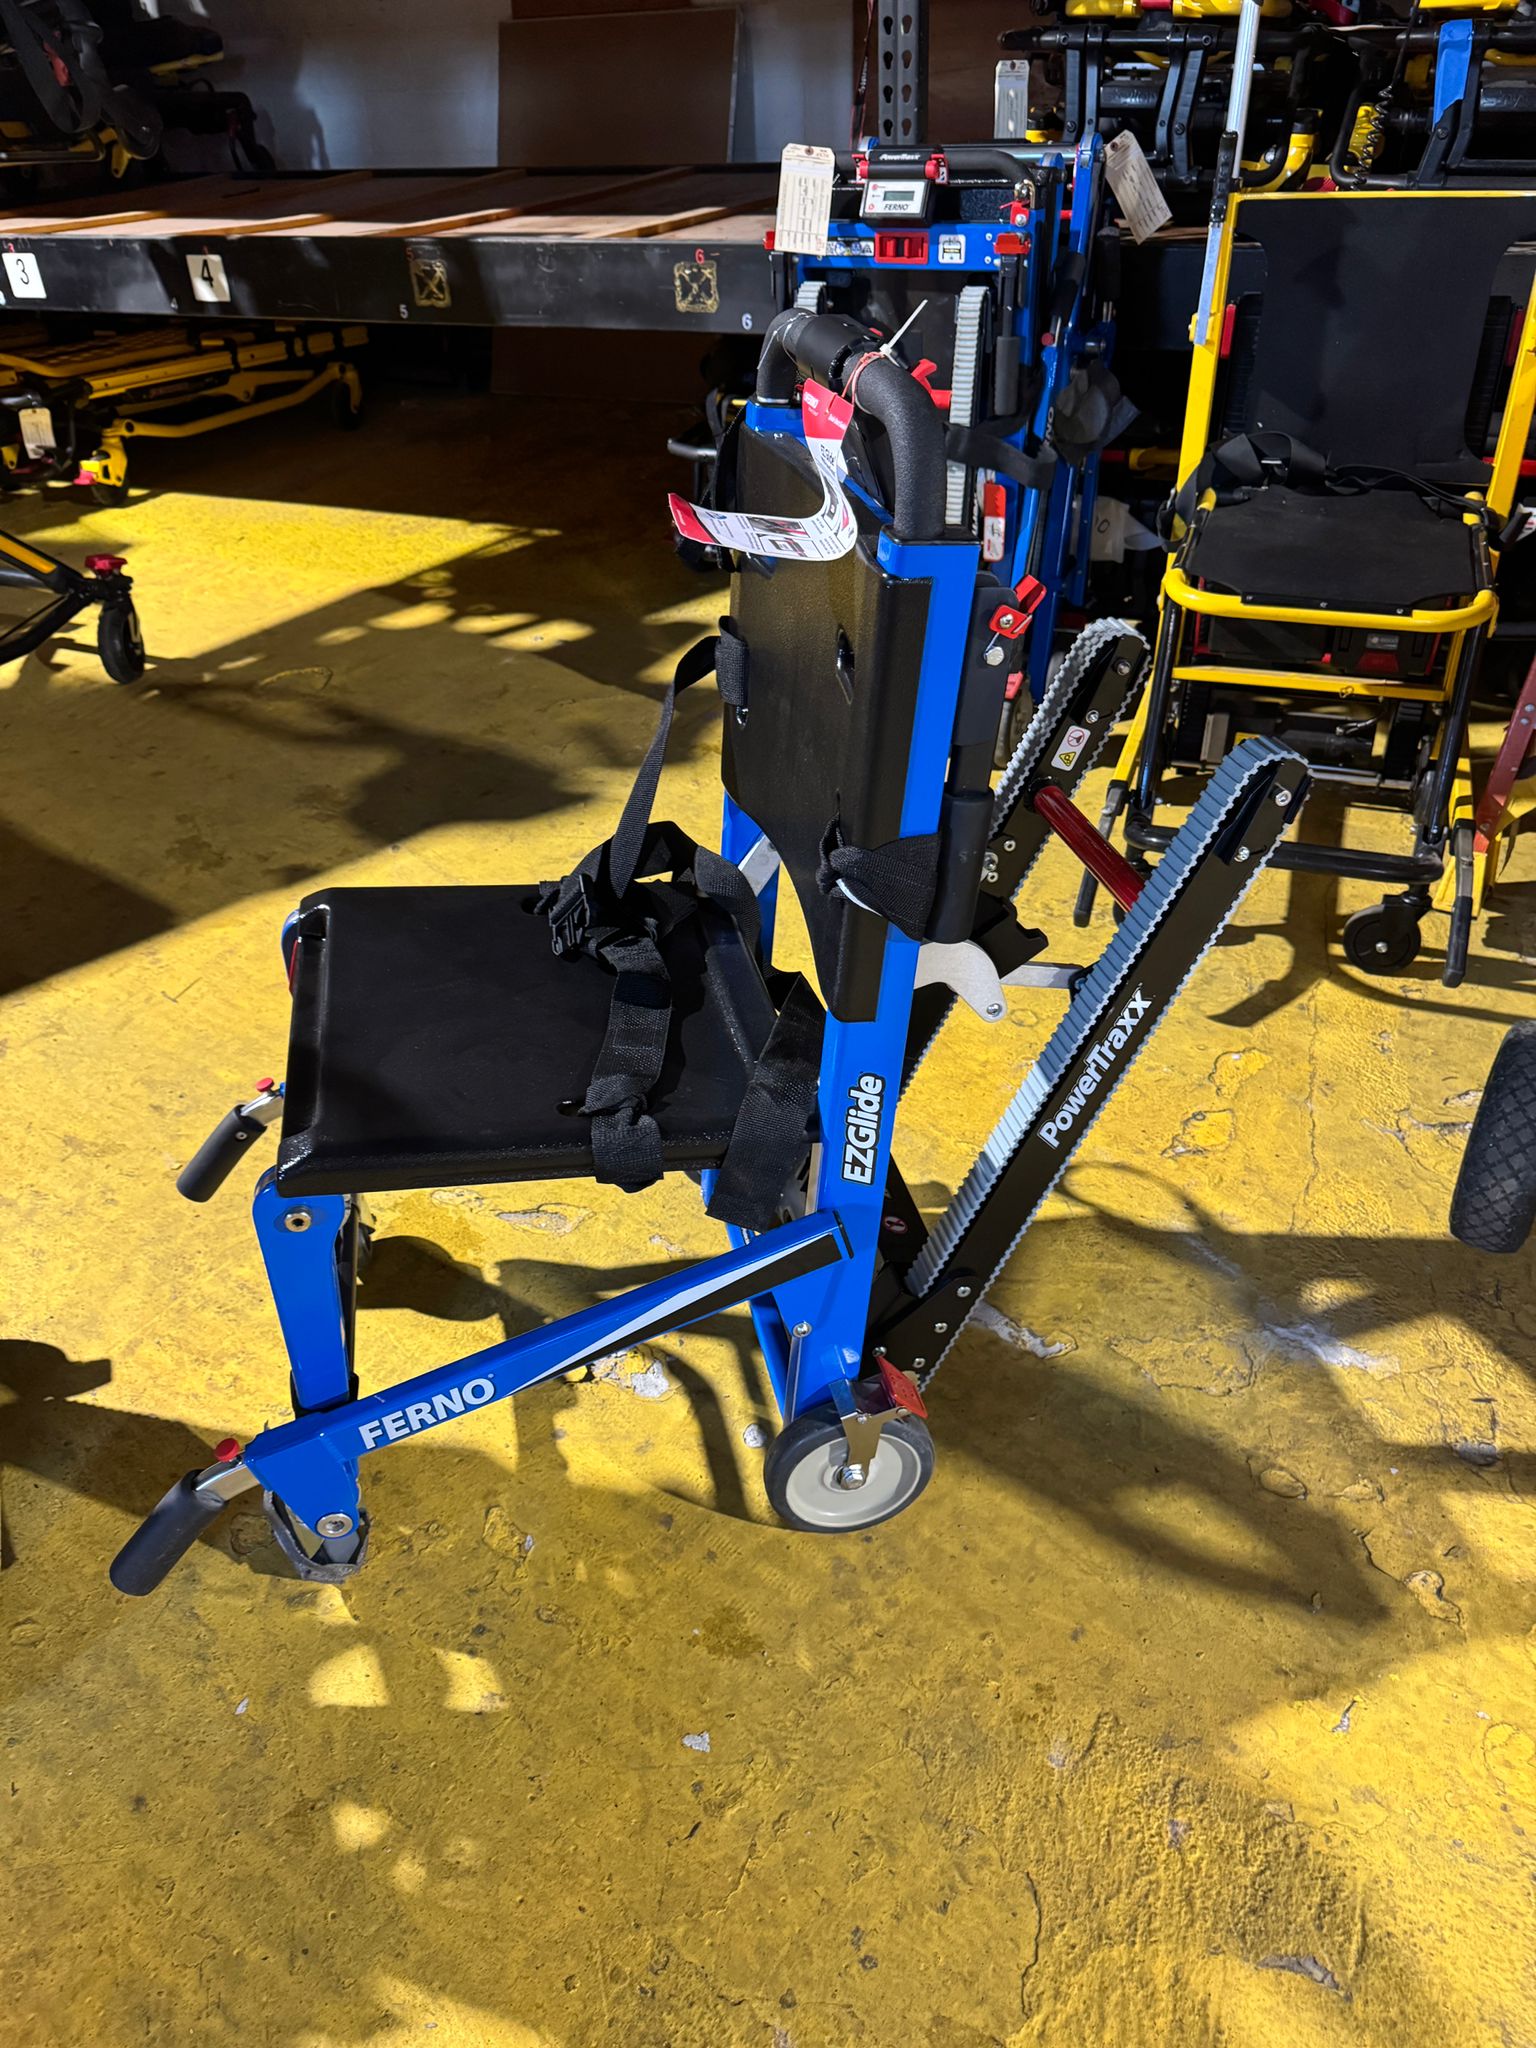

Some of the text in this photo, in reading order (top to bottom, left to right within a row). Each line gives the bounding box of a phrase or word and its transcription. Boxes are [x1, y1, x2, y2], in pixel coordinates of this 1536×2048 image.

[883, 203, 910, 212] FERNO
[695, 248, 705, 265] 6
[15, 258, 30, 285] 3
[201, 259, 214, 287] 4
[399, 304, 409, 319] 5
[741, 312, 753, 331] 6
[1038, 988, 1153, 1148] PowerTraxx
[843, 1075, 883, 1184] EZGlide
[358, 1378, 495, 1450] FERNO
